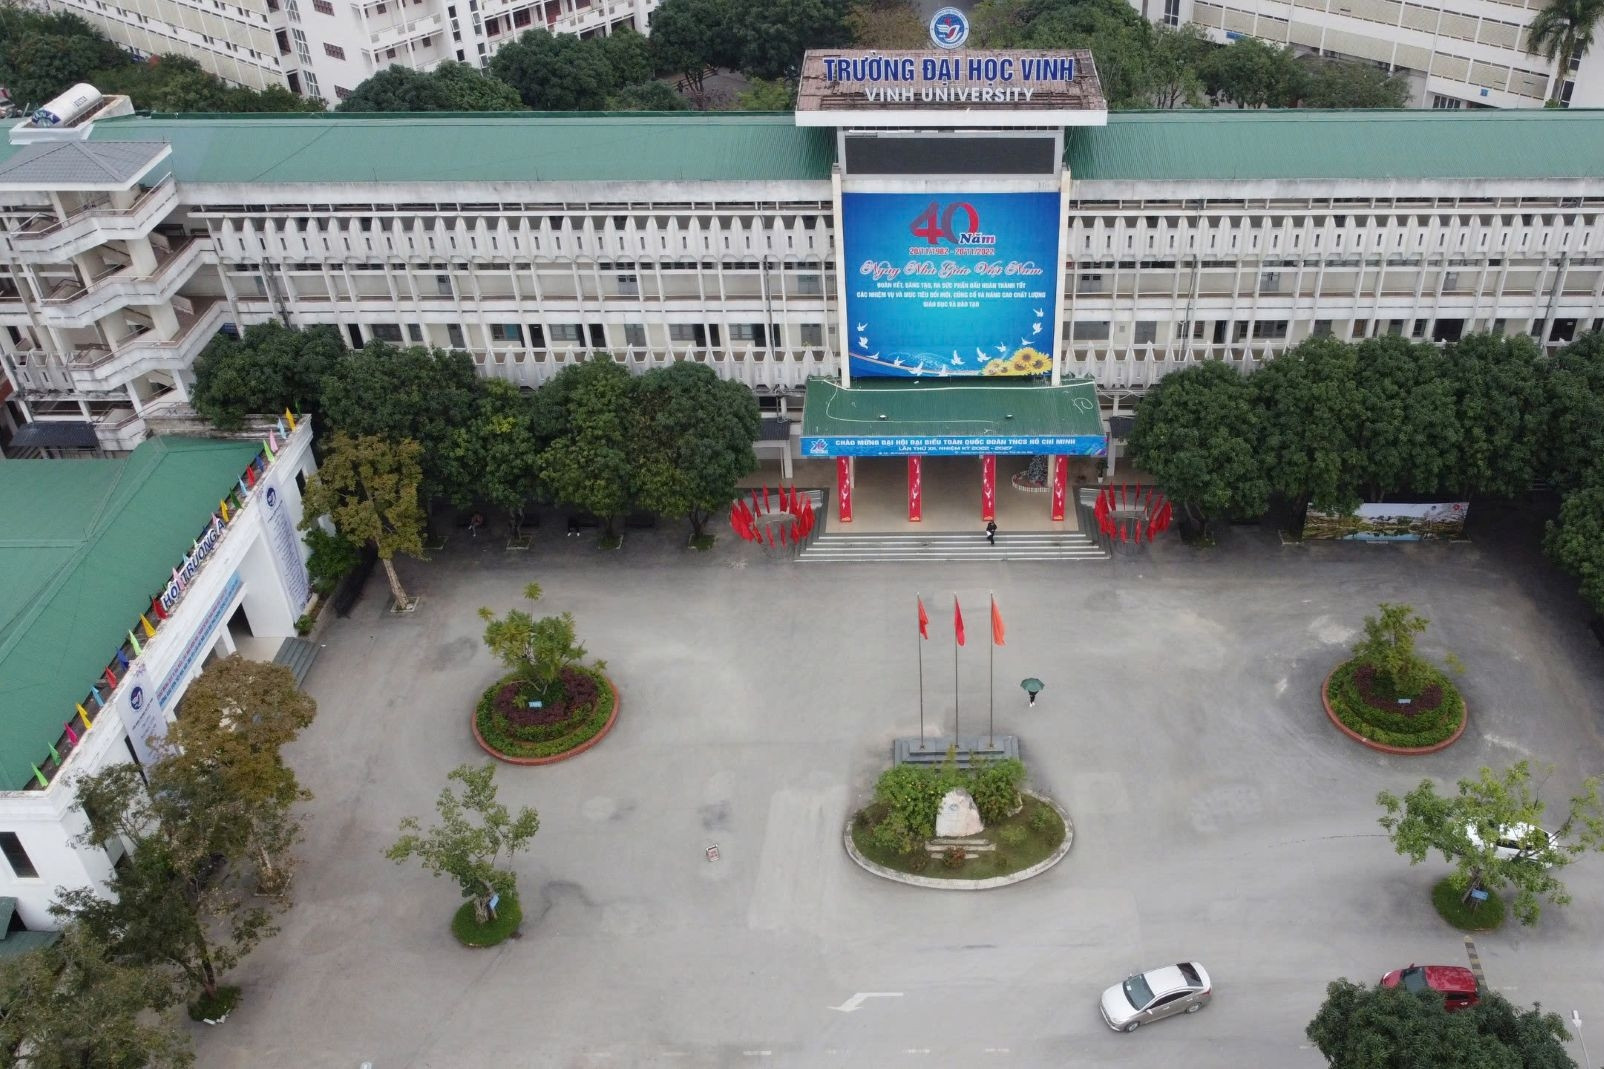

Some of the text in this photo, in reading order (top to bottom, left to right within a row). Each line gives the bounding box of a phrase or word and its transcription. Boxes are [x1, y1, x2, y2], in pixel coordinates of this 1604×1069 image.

[823, 51, 1074, 86] TRƯỜNG ĐẠI HỌC VINH
[865, 87, 1034, 102] VINH UNIVERSITY
[910, 201, 979, 244] 40
[959, 232, 996, 244] Năm
[835, 438, 855, 446] CHÀO
[1042, 438, 1054, 446] CHÍ
[1055, 438, 1076, 446] MINH
